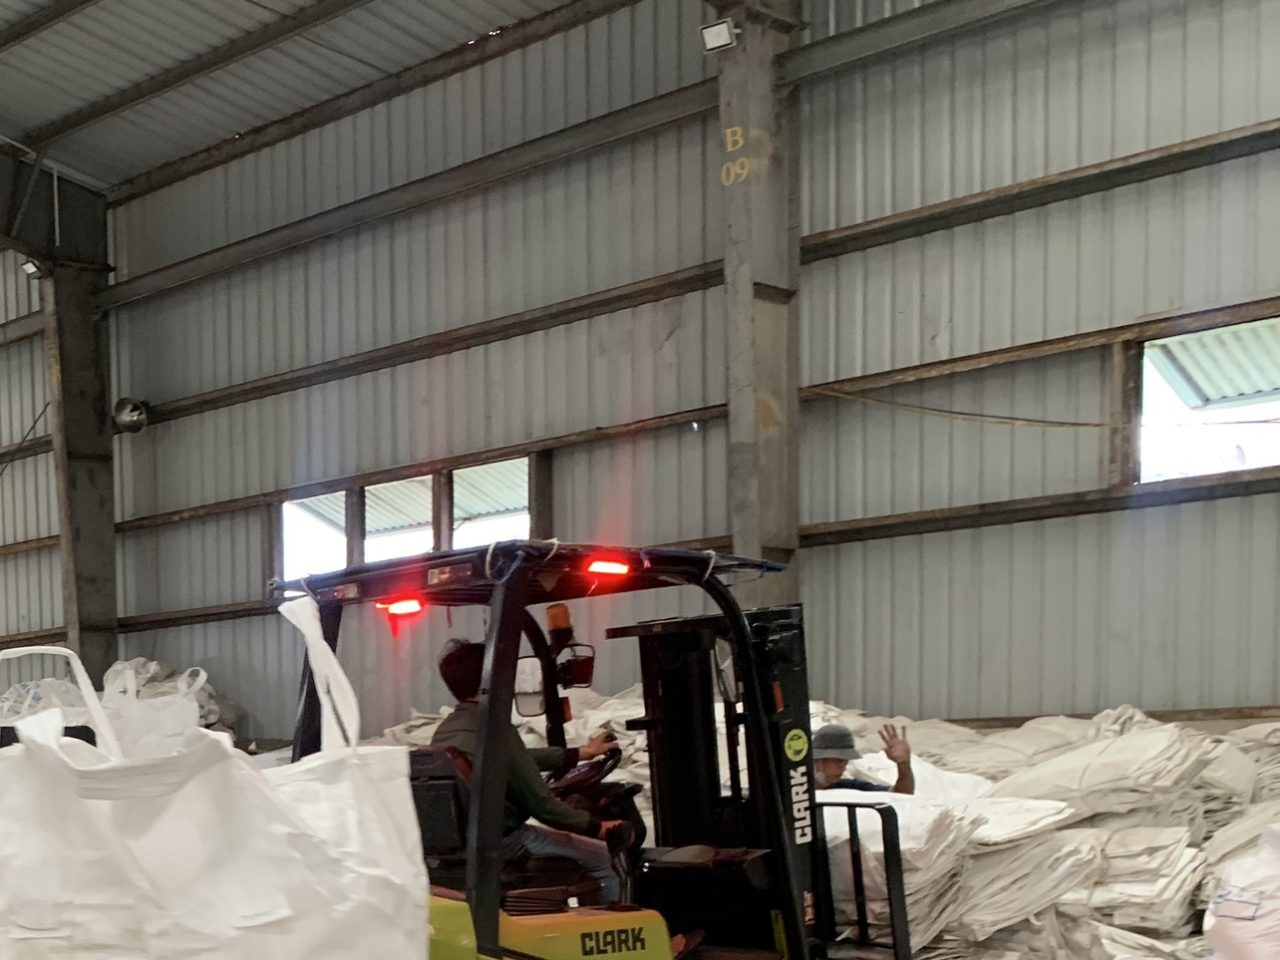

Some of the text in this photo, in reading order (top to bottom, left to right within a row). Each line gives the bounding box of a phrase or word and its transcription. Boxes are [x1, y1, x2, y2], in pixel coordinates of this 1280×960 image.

[725, 126, 745, 152] B
[721, 158, 750, 187] 09
[789, 765, 813, 845] CLARK
[580, 927, 646, 956] CLARK
